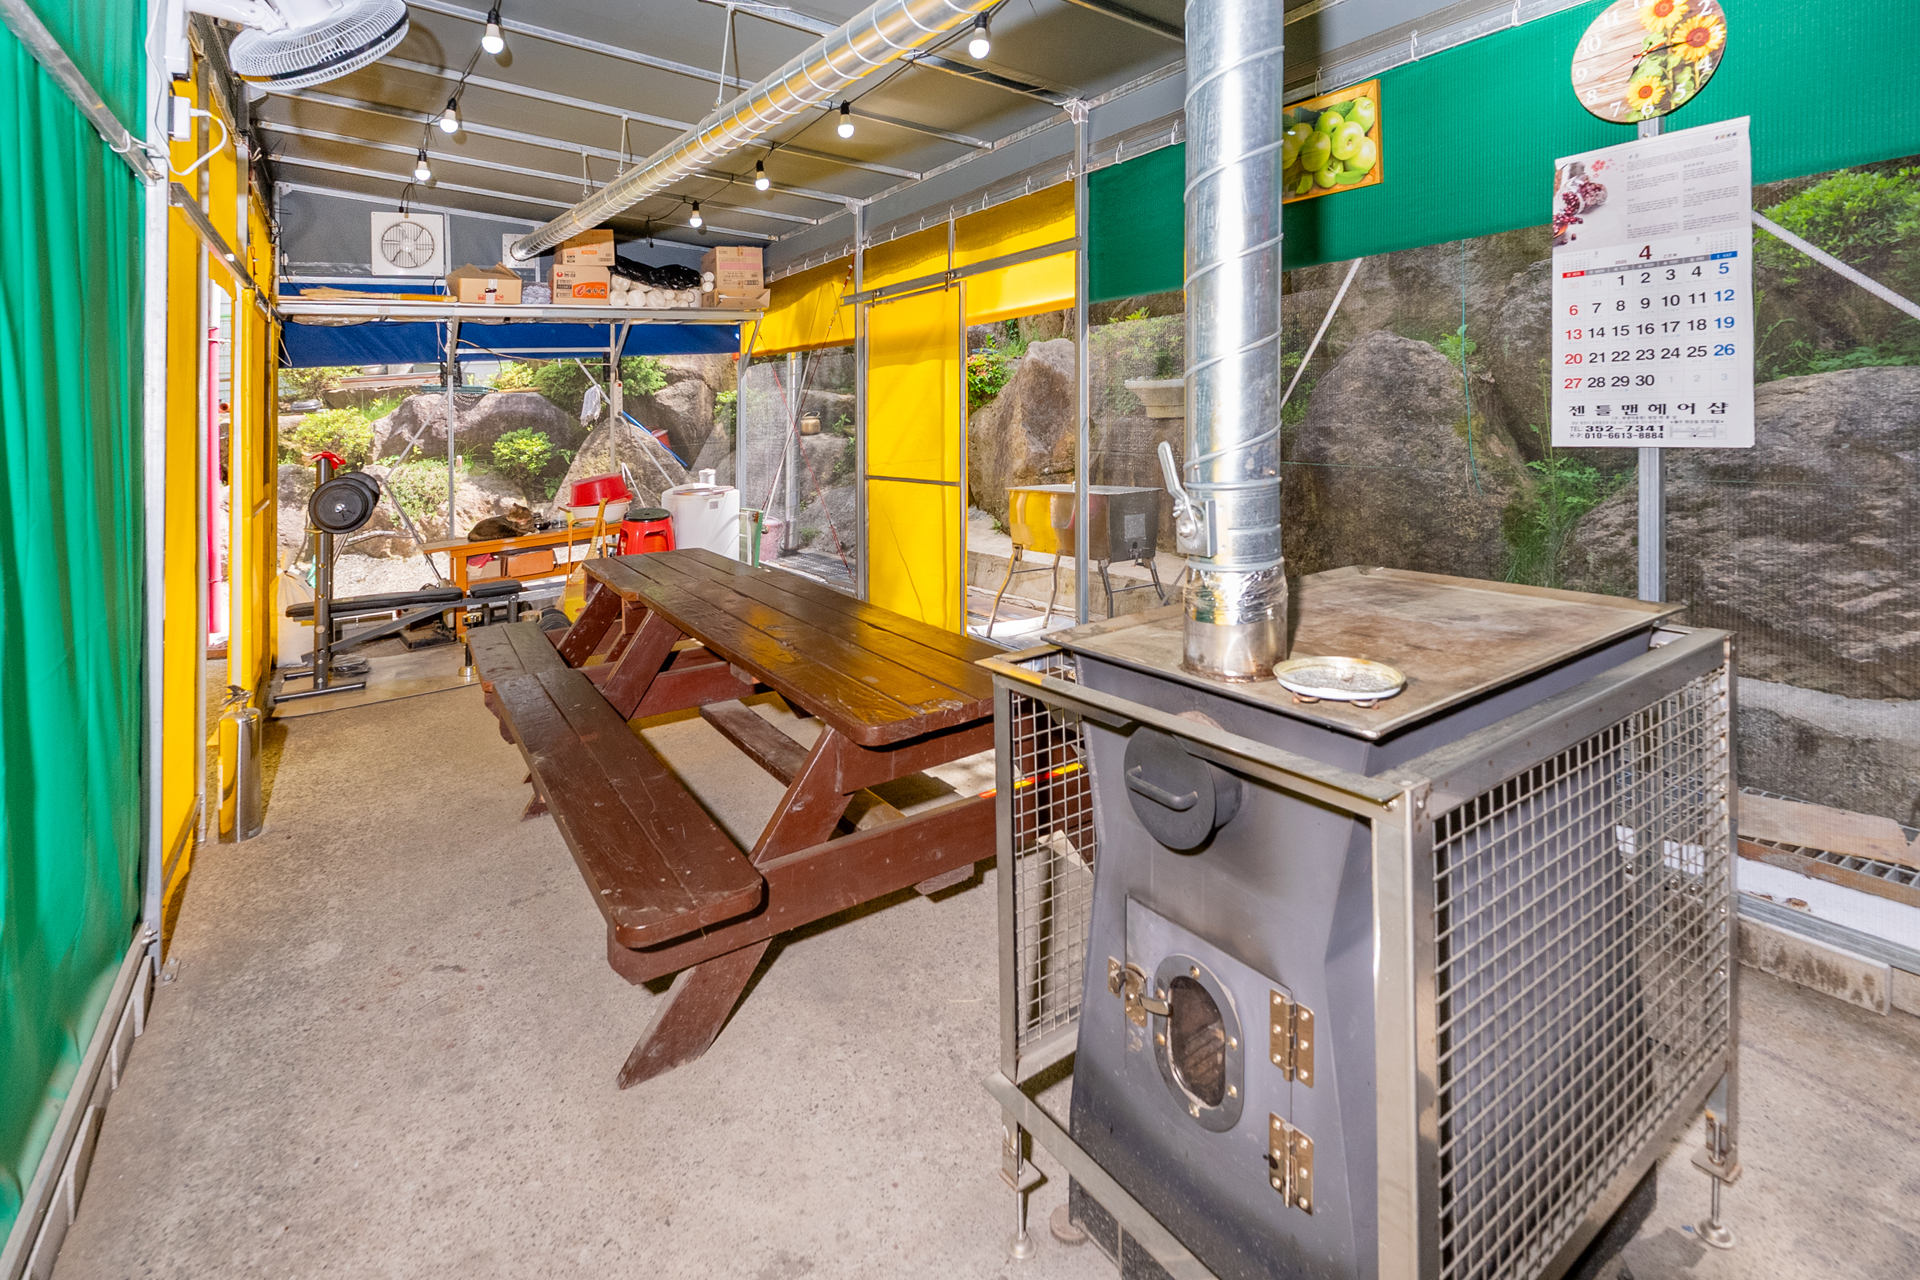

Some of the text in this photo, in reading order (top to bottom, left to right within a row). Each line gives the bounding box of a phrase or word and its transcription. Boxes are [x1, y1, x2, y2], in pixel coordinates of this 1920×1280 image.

[1698, 0, 1713, 16] 2
[1602, 9, 1619, 28] 11
[1709, 25, 1723, 44] 3
[1581, 35, 1602, 56] 10
[1698, 55, 1713, 73] 4
[1575, 67, 1588, 84] 9
[1585, 88, 1598, 105] 8
[1675, 82, 1687, 101] 5
[1609, 100, 1622, 118] 7
[1641, 99, 1655, 117] 6
[1638, 244, 1653, 261] 4
[1591, 279, 1603, 287] 31
[1617, 274, 1625, 286] 1
[1640, 271, 1652, 284] 2
[1665, 268, 1677, 281] 3
[1691, 265, 1702, 278] 4
[1718, 261, 1730, 274] 5
[1568, 288, 1736, 317] 6 7 8 9 10 11 12
[1564, 315, 1736, 341] 13 14 15 16 17 18 19
[1564, 343, 1736, 366] 20 21 22 23 24 25 26
[1564, 377, 1582, 390] 27
[1587, 376, 1607, 389] 28
[1610, 375, 1631, 388] 29
[1634, 374, 1656, 387] 30
[1693, 374, 1701, 382] 2
[1720, 373, 1728, 381] 3
[1585, 432, 1664, 440] 010-6613-8884
